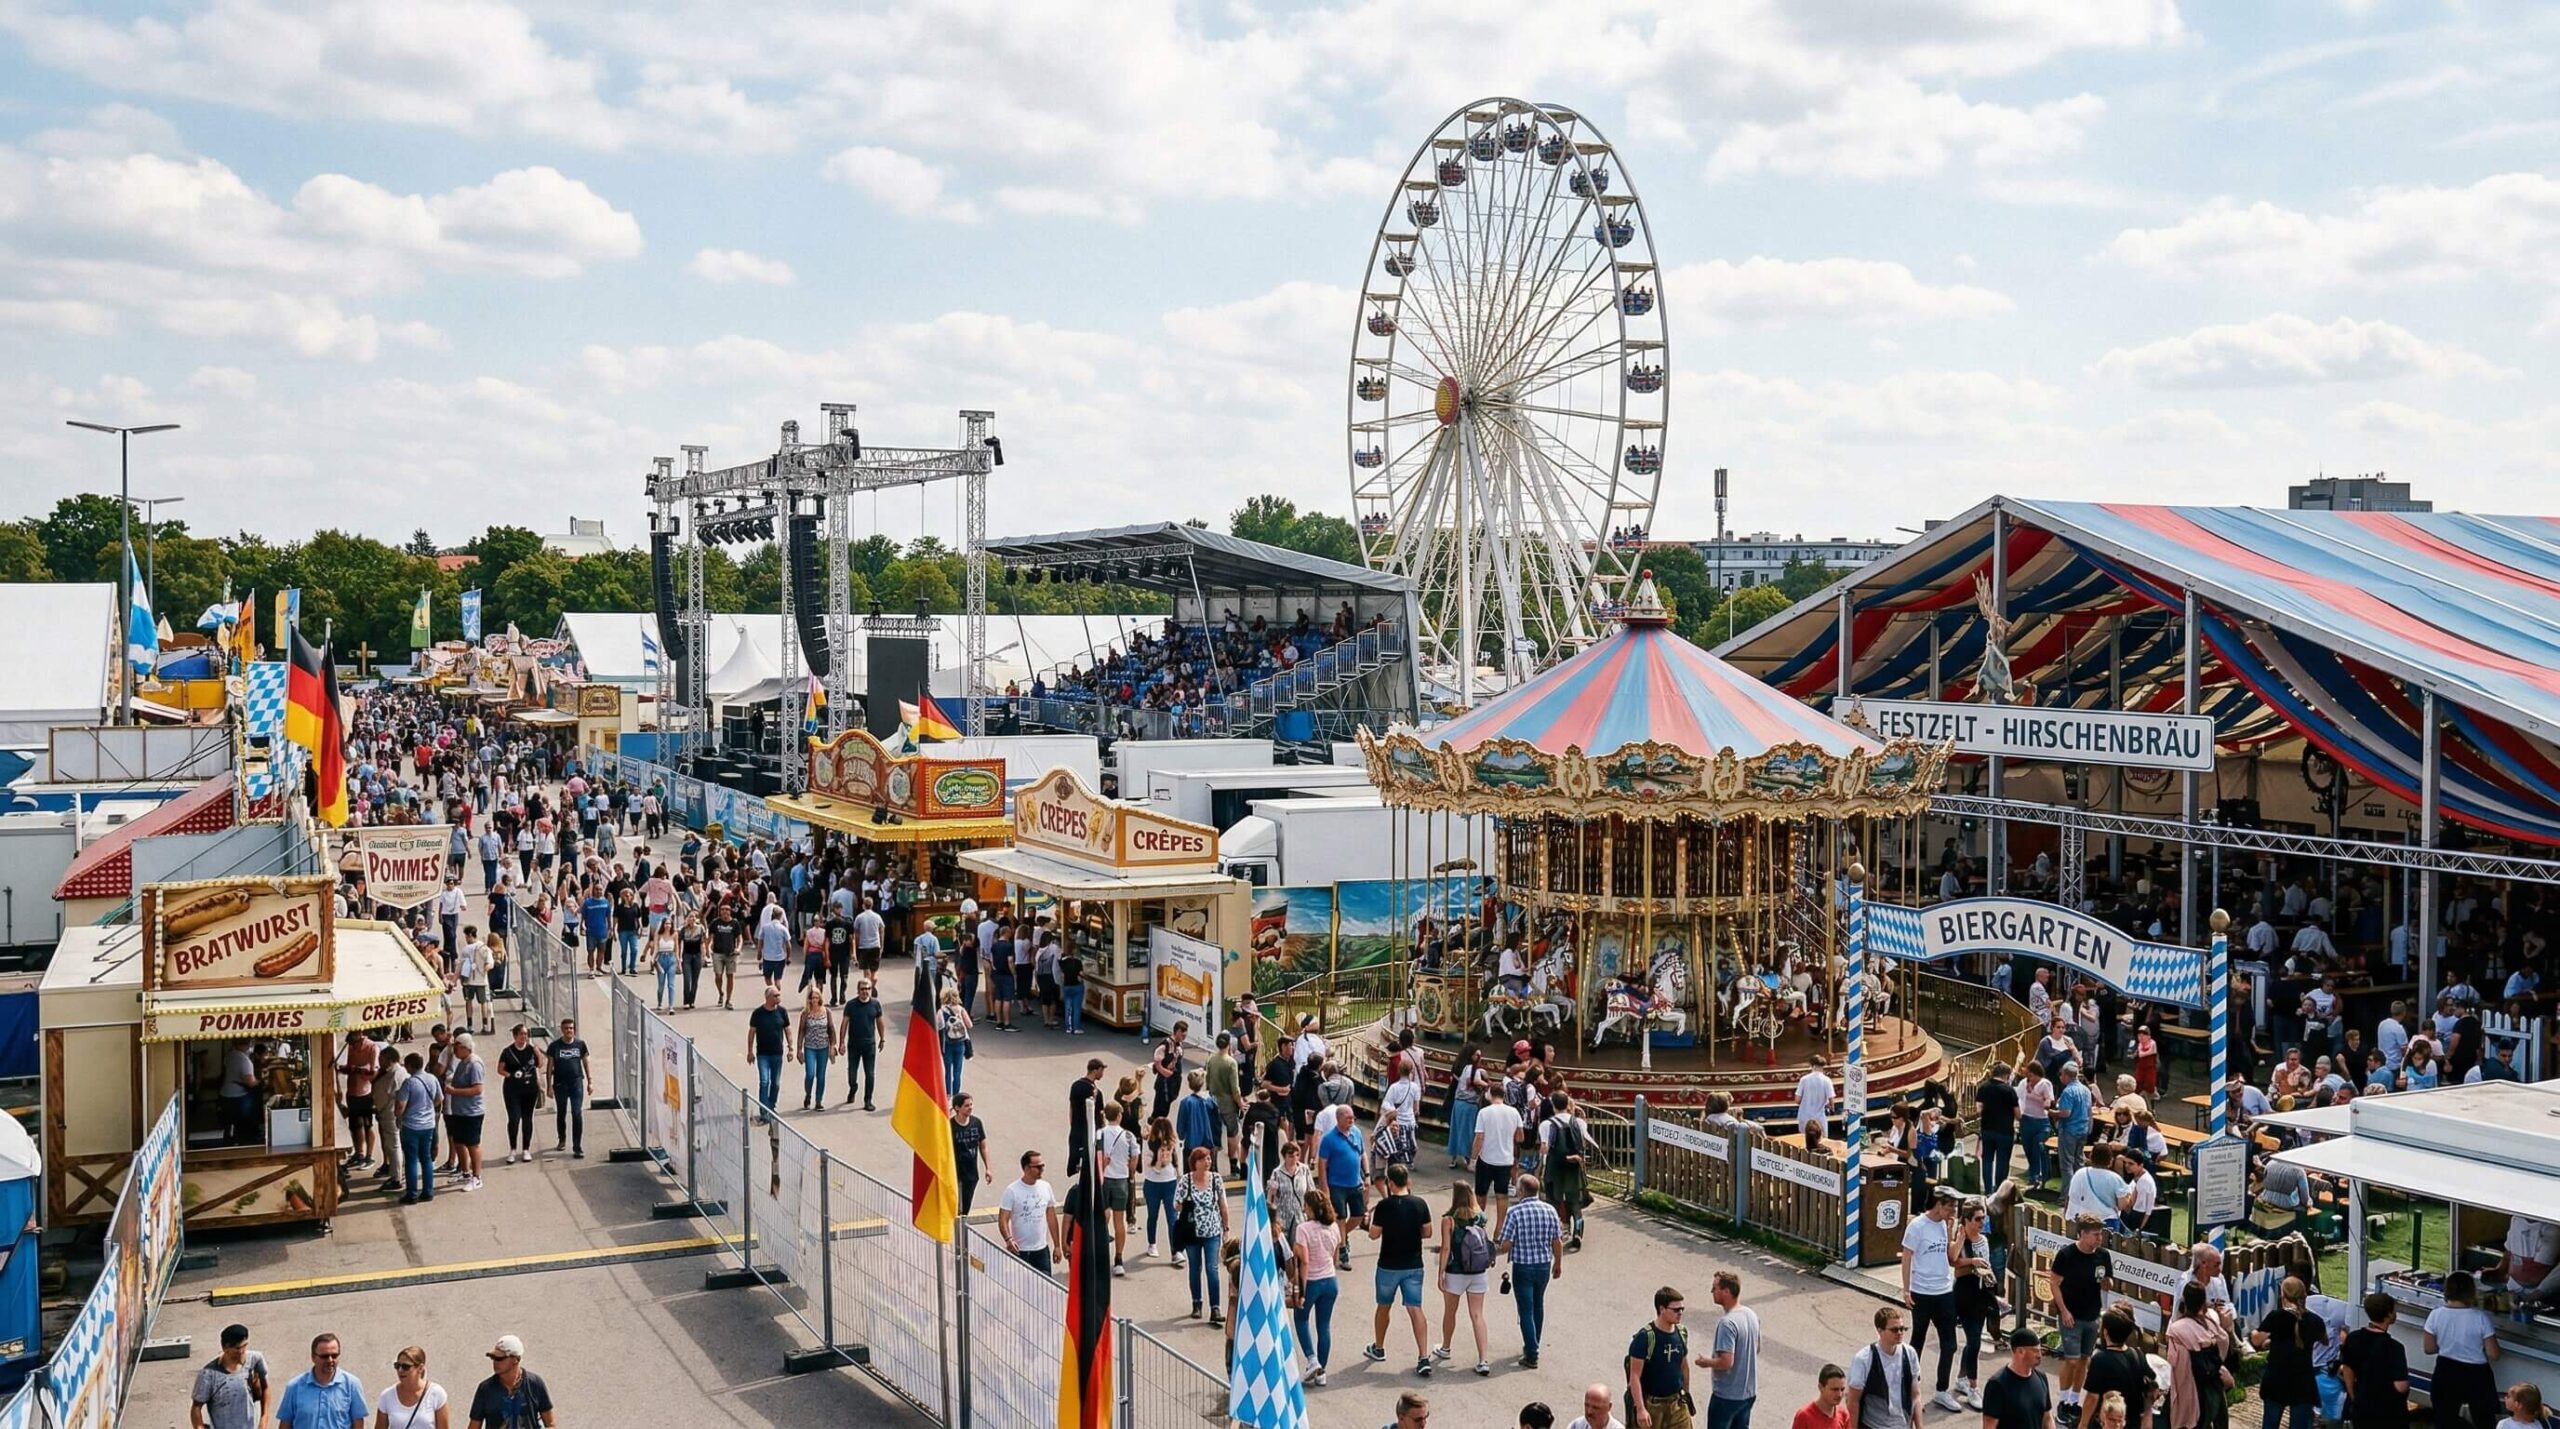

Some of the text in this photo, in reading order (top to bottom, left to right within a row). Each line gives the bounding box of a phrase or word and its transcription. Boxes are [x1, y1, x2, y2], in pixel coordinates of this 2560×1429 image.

[1880, 711, 1977, 742] FESTZELT
[2003, 718, 2200, 758] HIRSCHENBRÄU
[1133, 829, 1203, 852] CRÊPES
[368, 851, 440, 883] POMMES
[174, 903, 310, 975] BRATWURST
[1939, 911, 2111, 970] BIERGARTEN
[199, 998, 427, 1032] POMMES CRÉPES
